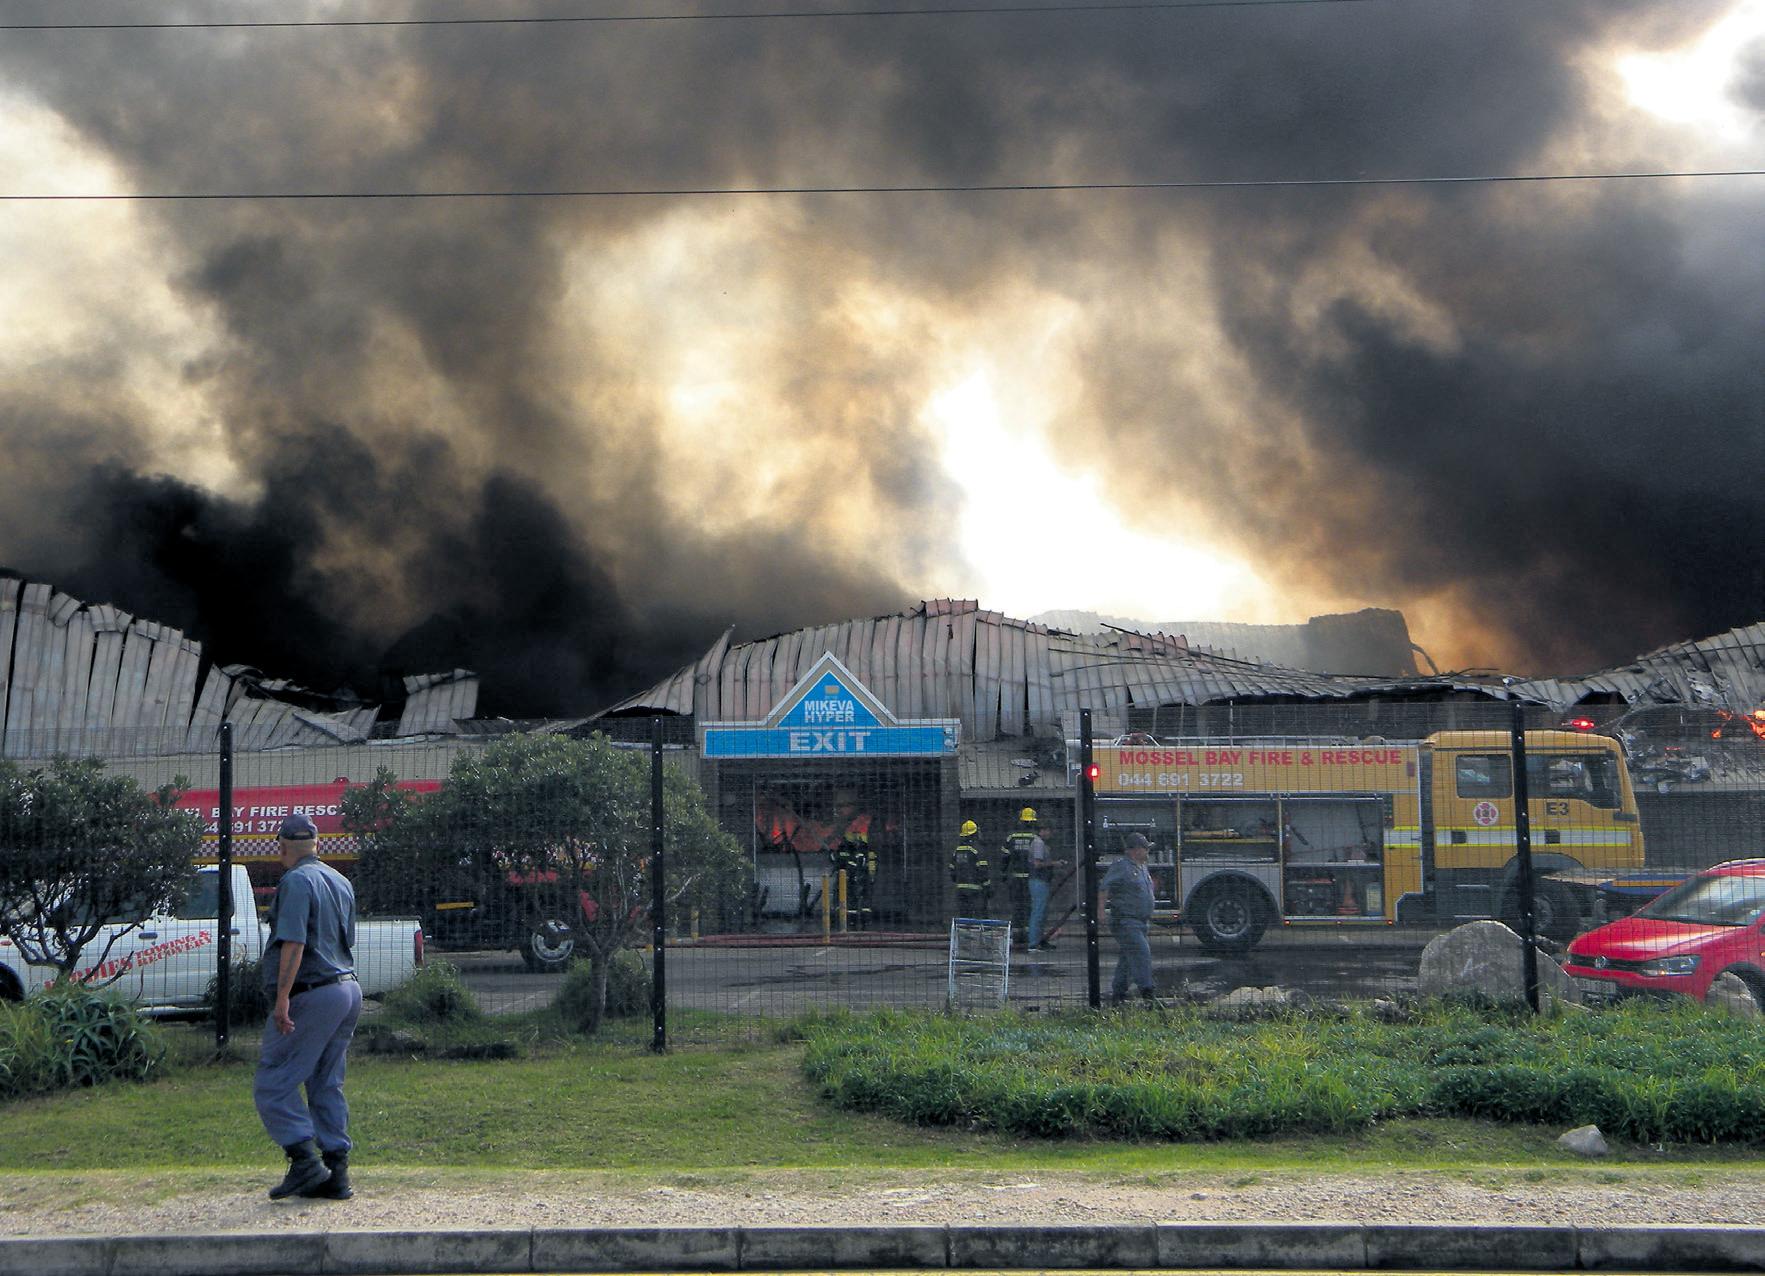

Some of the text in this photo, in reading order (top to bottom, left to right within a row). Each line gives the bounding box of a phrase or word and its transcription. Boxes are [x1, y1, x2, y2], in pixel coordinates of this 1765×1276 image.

[804, 700, 854, 711] MIKEVA
[804, 711, 854, 723] HYPER
[790, 732, 871, 751] EXIT
[1119, 750, 1402, 766] MOSSEL BAY FIRE & RESCUE
[1118, 773, 1243, 787] 044 691 3722
[211, 806, 245, 818] BY
[249, 806, 289, 817] FIRE
[1546, 802, 1569, 816] E3
